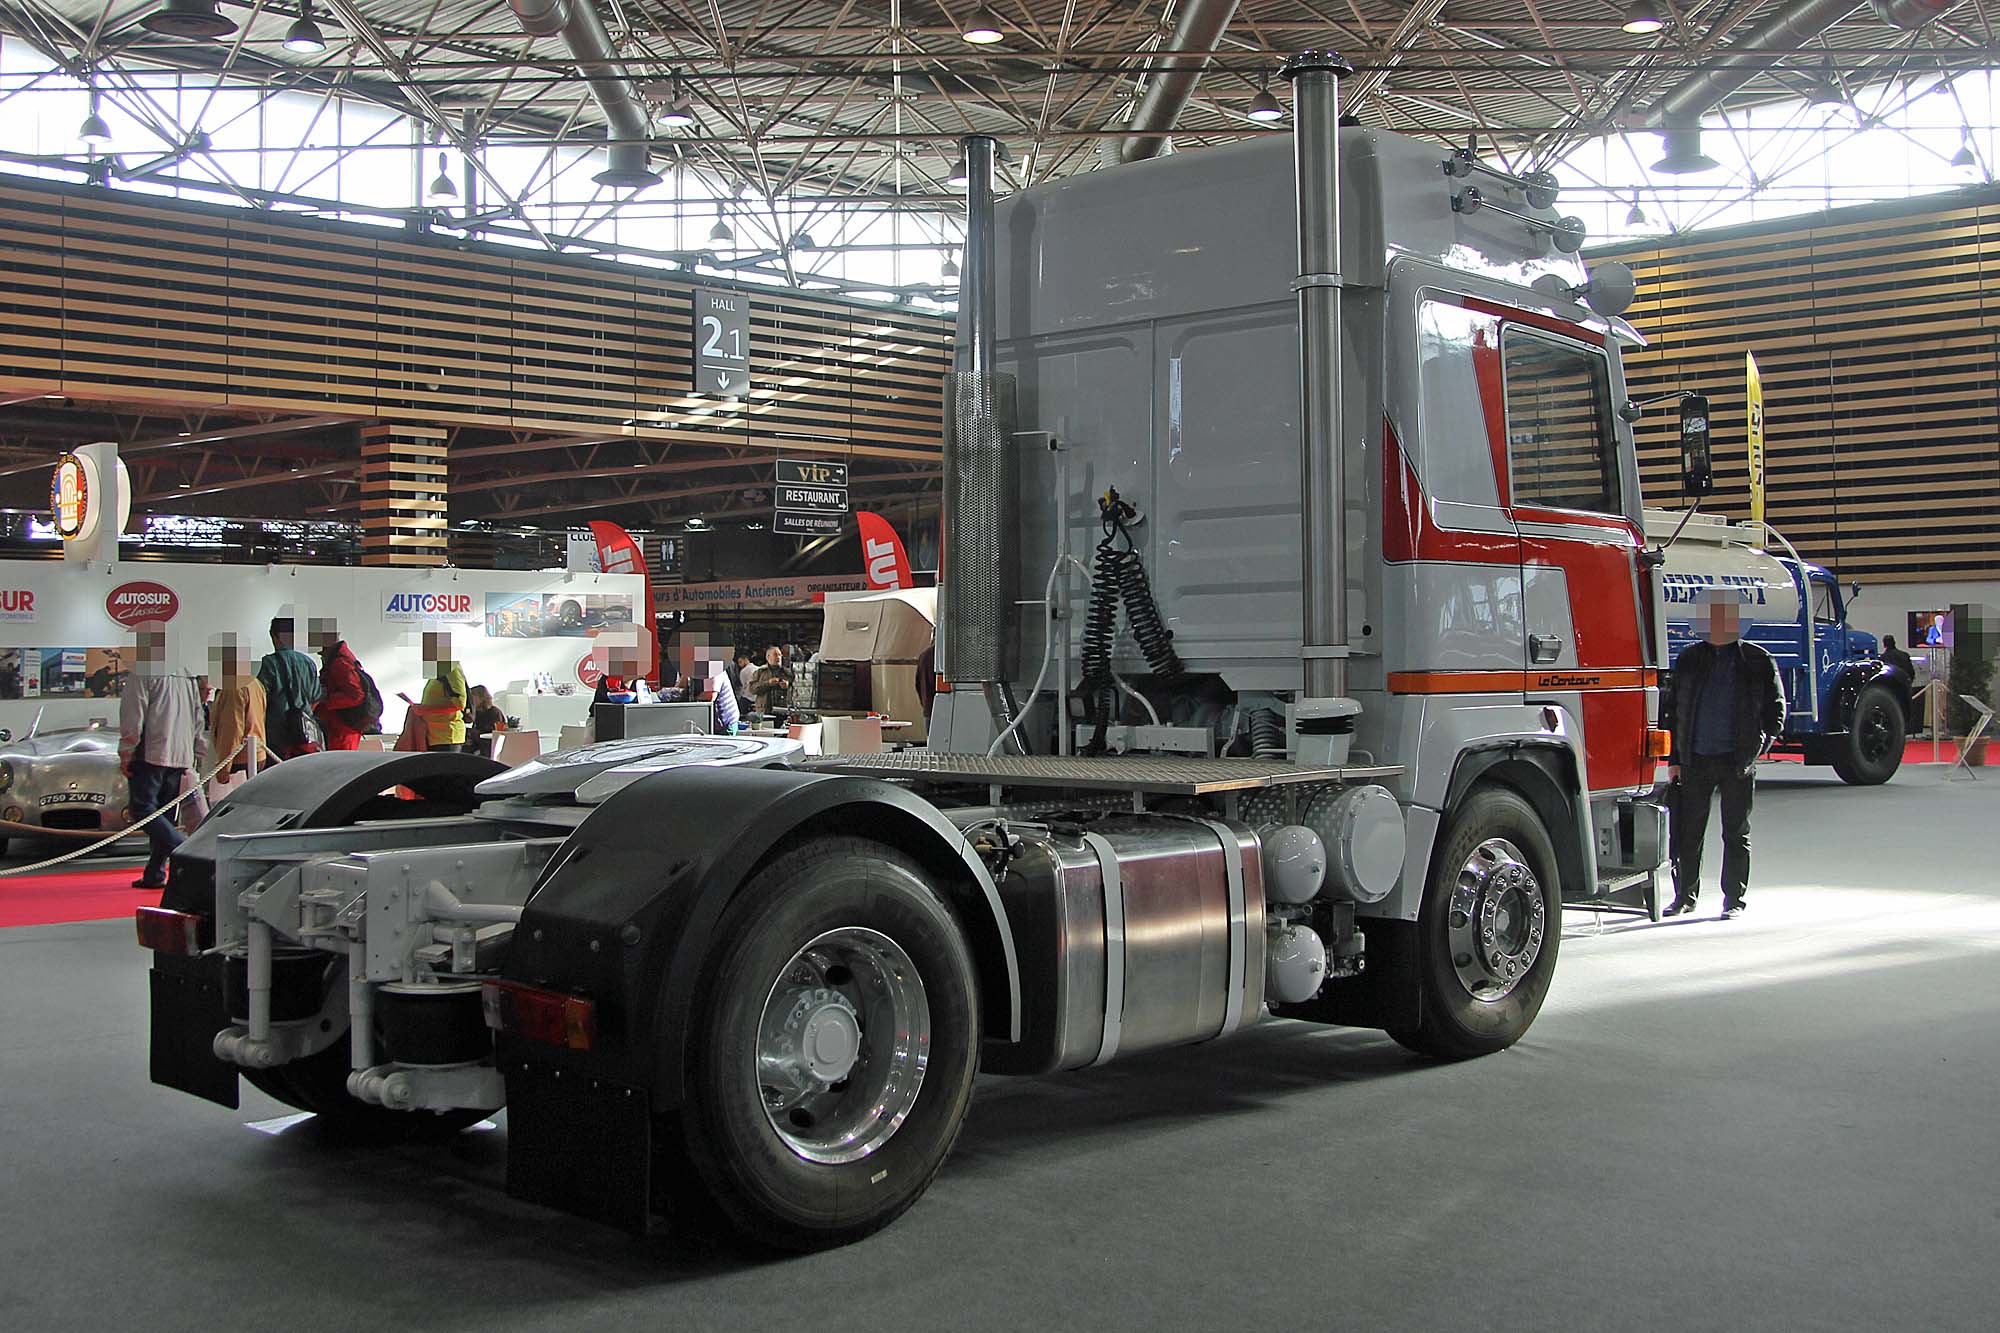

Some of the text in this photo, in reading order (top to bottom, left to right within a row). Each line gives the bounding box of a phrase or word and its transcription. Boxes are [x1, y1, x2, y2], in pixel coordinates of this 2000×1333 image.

[711, 298, 736, 312] HALL
[702, 316, 745, 360] 2.1
[785, 490, 840, 504] RESTAURANT
[783, 517, 806, 527] SALLES
[806, 519, 814, 527] DE
[673, 587, 741, 601] d'Automobiles
[745, 584, 795, 599] Anciennes
[807, 582, 860, 592] ORGANISATEUR
[0, 591, 34, 611] UR
[114, 592, 171, 605] AUTOSUR
[386, 593, 471, 613] AUTOSUR
[117, 604, 170, 619] Classic
[1538, 674, 1600, 687] Le Centaure
[69, 792, 89, 801] ZW
[91, 794, 105, 804] 42
